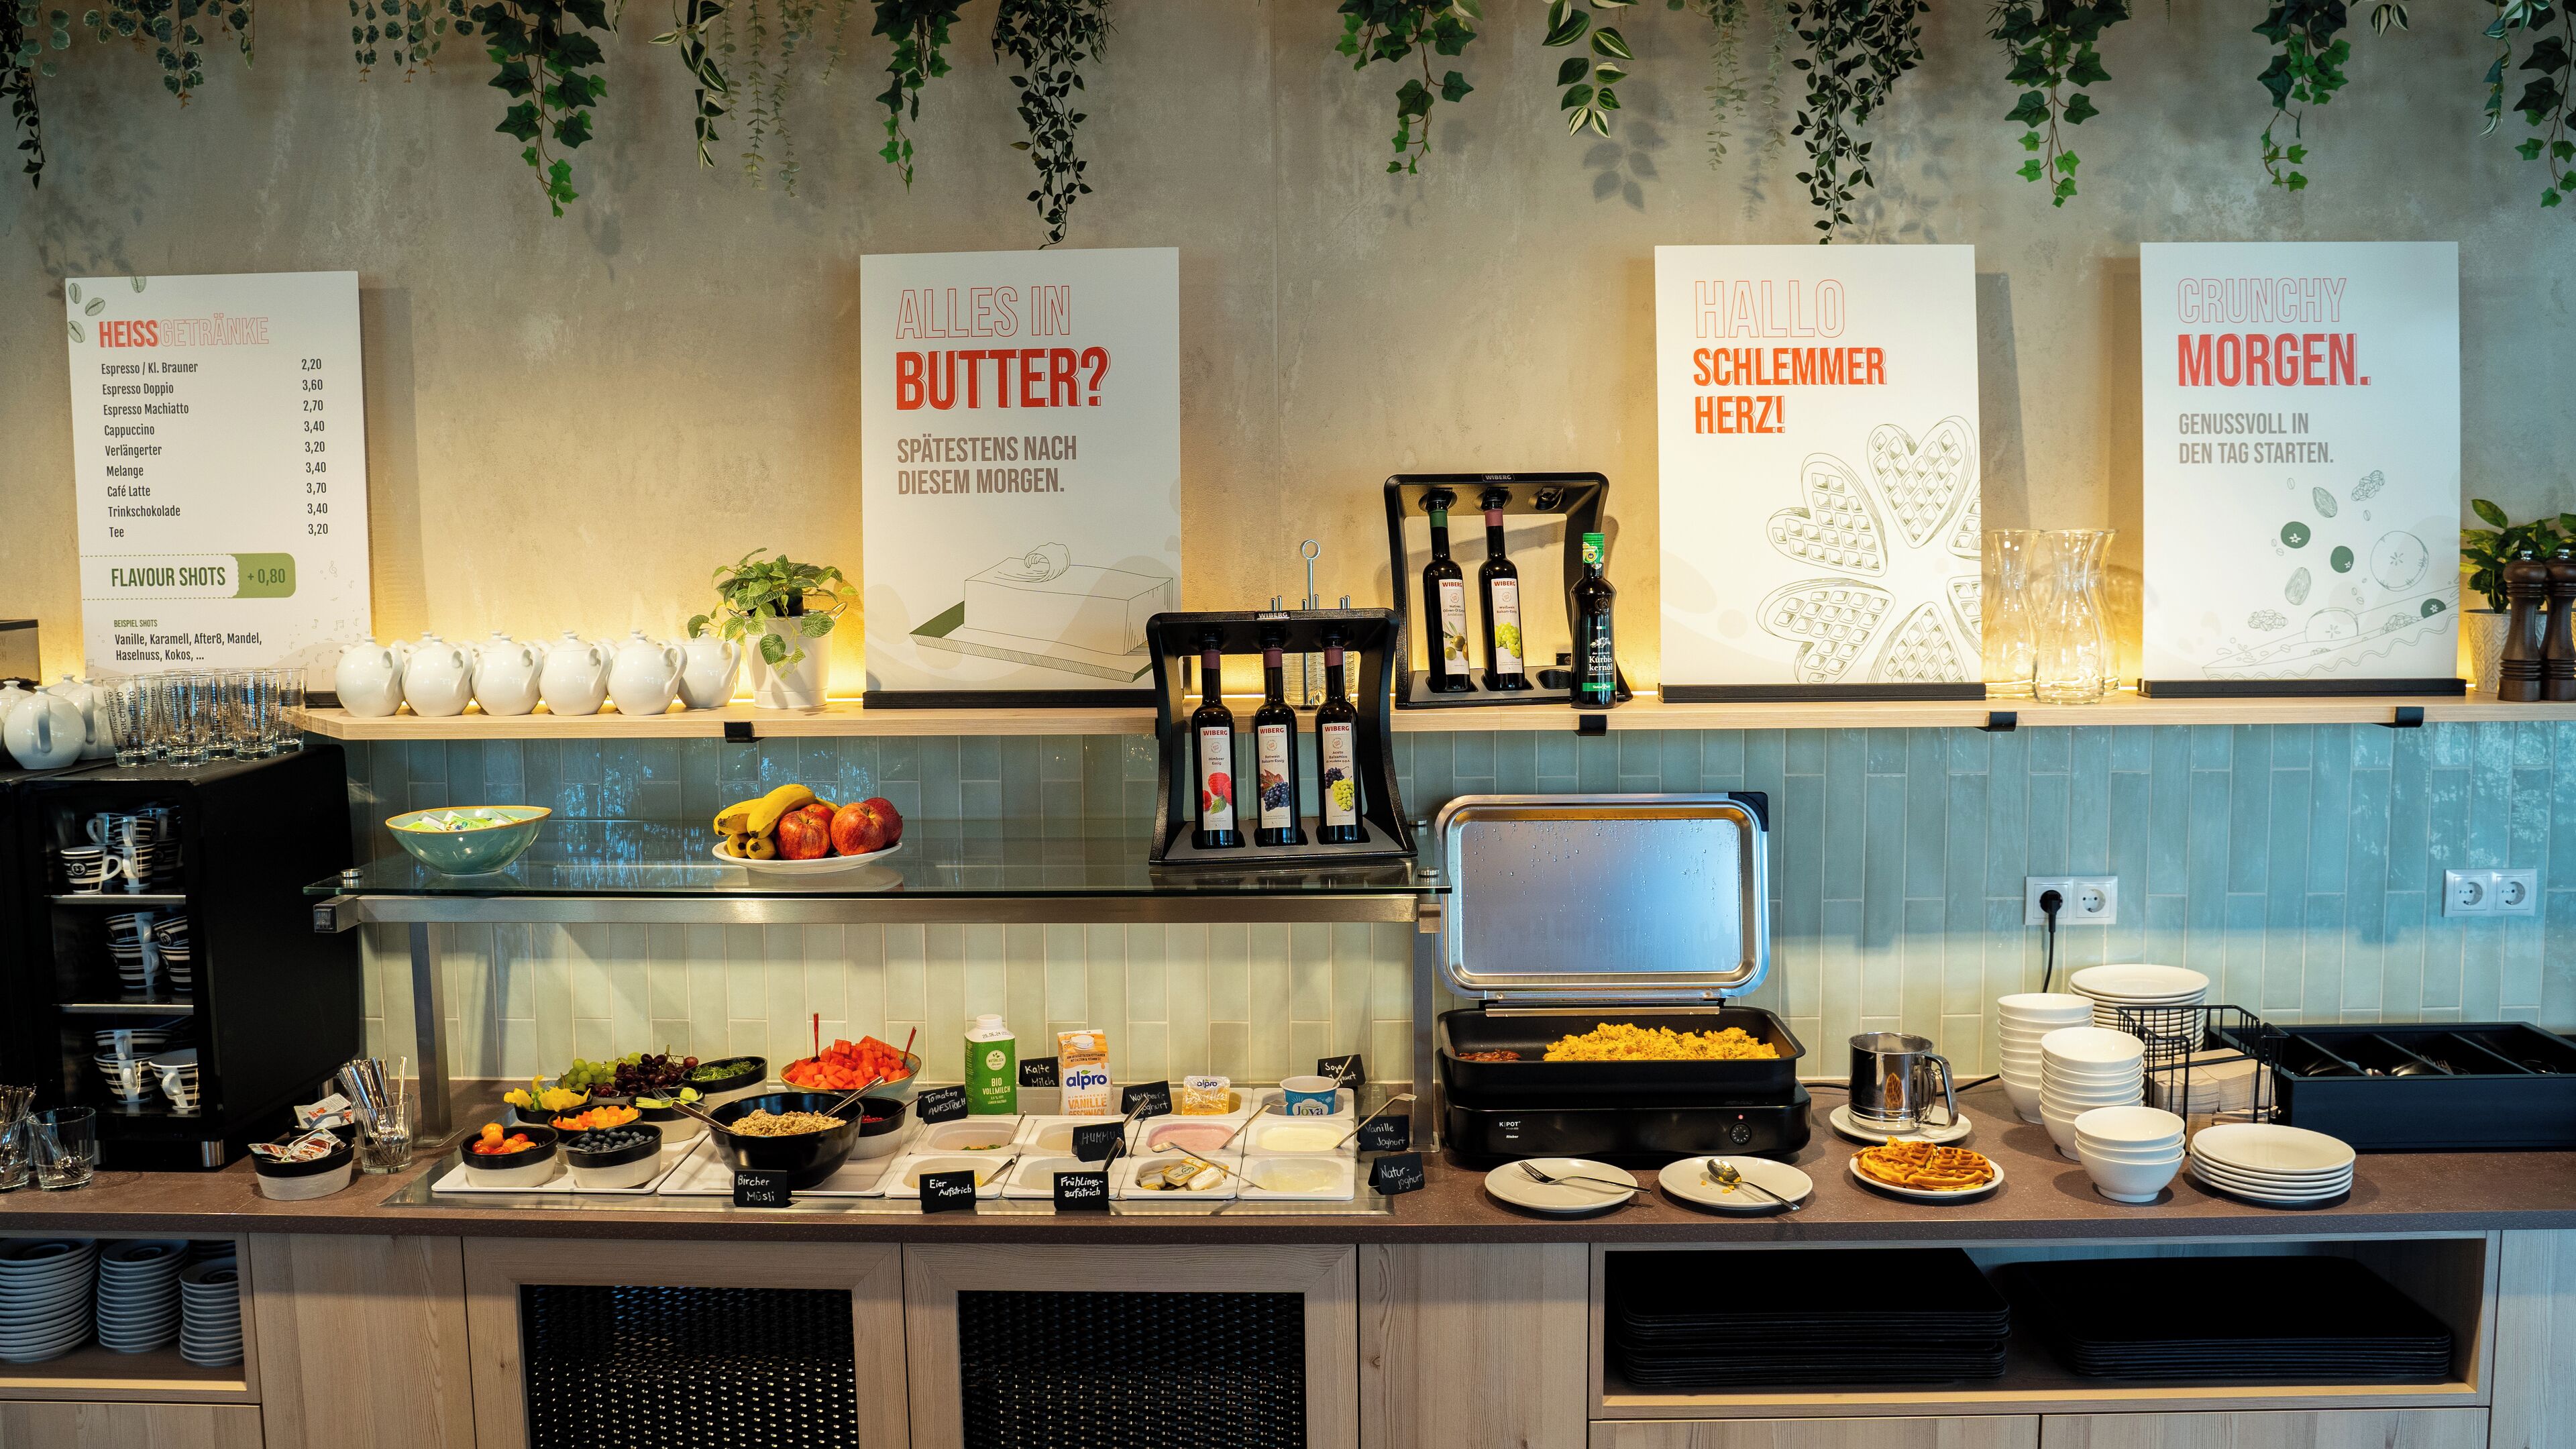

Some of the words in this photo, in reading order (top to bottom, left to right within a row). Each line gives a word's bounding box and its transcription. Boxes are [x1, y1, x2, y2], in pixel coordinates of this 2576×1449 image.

[2178, 276, 2347, 324] CRUNCHY
[896, 286, 1018, 339] ALLES
[1032, 286, 1070, 335] IN
[1695, 279, 1845, 338] HALLO
[302, 359, 321, 371] 2,20
[2178, 333, 2371, 386] MORGEN.
[101, 364, 140, 376] Espresso
[142, 362, 145, 375] /
[148, 362, 159, 373] Kl.
[162, 362, 198, 373] Brauner
[1693, 347, 1887, 386] SCHLEMMER
[896, 347, 1111, 411] BUTTER?
[103, 384, 140, 397] Espresso
[144, 382, 173, 396] Doppio
[303, 380, 323, 392] 3,60
[104, 405, 142, 417] Espresso
[145, 402, 189, 414] Machiatto
[303, 400, 323, 413] 2,70
[1695, 396, 1785, 433] HERZ!
[105, 423, 154, 438] Cappuccino
[305, 421, 324, 433] 3,40
[2180, 413, 2287, 435] GENUSSVOLL
[2292, 413, 2308, 433] IN
[105, 444, 162, 458] Verlängerter
[305, 441, 325, 453] 3,20
[898, 433, 1018, 463] SPÄTESTENS
[1024, 435, 1076, 460] NACH
[2180, 443, 2212, 464] DEN
[2217, 442, 2249, 464] TAG
[2254, 442, 2334, 464] STARTEN.
[107, 465, 143, 478] Melange
[306, 462, 326, 474] 3,40
[898, 470, 969, 494] DIESEM
[977, 468, 1064, 493] MORGEN.
[107, 485, 125, 496] Café
[129, 486, 150, 496] Latte
[307, 482, 326, 495] 3,70
[108, 505, 180, 517] Trinkschokolade
[307, 503, 327, 515] 3,40
[109, 527, 123, 537] Tee
[309, 523, 328, 536] 3,20
[111, 568, 174, 586] FLAVOUR
[179, 567, 225, 586] SHOTS
[258, 569, 285, 586] 0,80
[140, 619, 158, 627] SHOTS
[115, 633, 147, 646] Vanille,
[150, 633, 191, 646] Karamell,
[195, 633, 224, 645] After8,
[227, 633, 262, 645] Mandel,
[116, 649, 162, 661] Haselnuss,
[166, 649, 193, 661] Kokos,
[1025, 1065, 1050, 1075] Kalte
[991, 1078, 1002, 1087] BIO
[1031, 1077, 1055, 1087] Milch
[1066, 1071, 1107, 1089] alpro
[1197, 1079, 1217, 1088] alpro
[925, 1090, 958, 1104] Tomaten
[983, 1086, 1010, 1095] VOLLMILCH
[1068, 1097, 1107, 1109] VANILLE
[1365, 1123, 1394, 1132] Vanille
[1377, 1136, 1406, 1148] Joghurt
[1381, 1165, 1409, 1179] Natur-
[738, 1175, 769, 1186] Bircher
[930, 1179, 947, 1188] Eier
[1398, 1171, 1422, 1189] joghurt
[938, 1185, 972, 1197] Aufstrich
[1065, 1189, 1100, 1198] aufstrich
